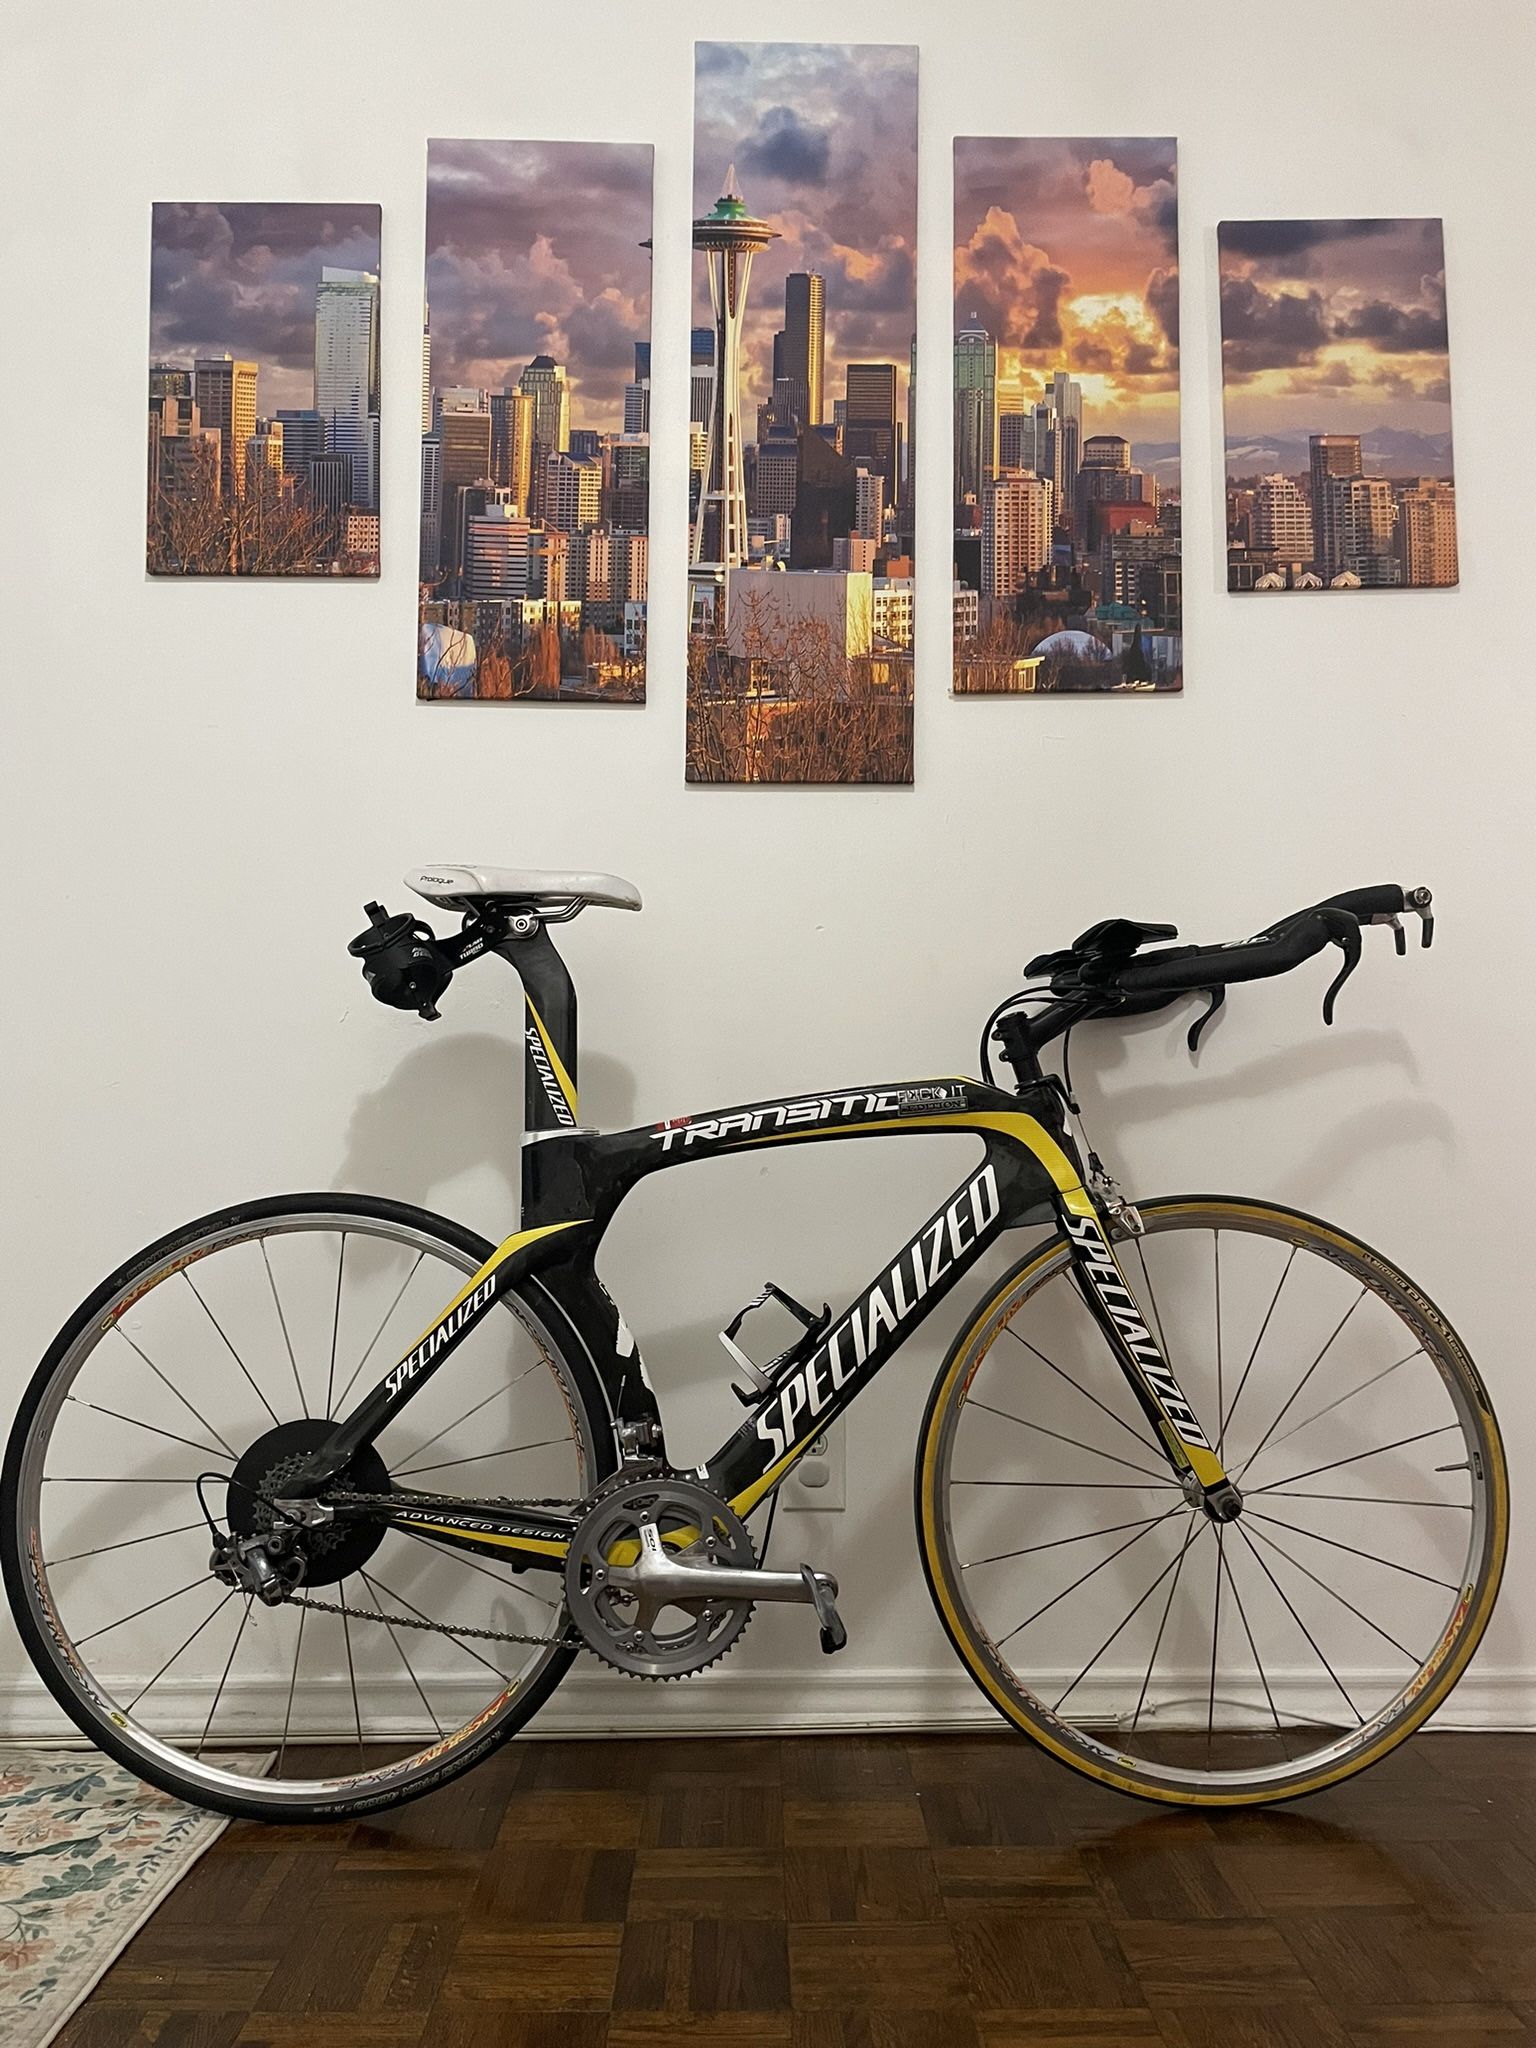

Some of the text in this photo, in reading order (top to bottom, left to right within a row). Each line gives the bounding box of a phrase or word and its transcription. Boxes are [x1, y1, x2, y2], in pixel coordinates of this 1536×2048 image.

[525, 1026, 574, 1127] SPECIALIZED
[756, 1164, 1000, 1474] SPECIALIZED
[1061, 1214, 1210, 1448] SPECIALIZED
[1372, 1259, 1405, 1289] MICHELIN
[385, 1274, 496, 1403] SPECIALIZED
[395, 1510, 566, 1540] ADVANCED DESIGN
